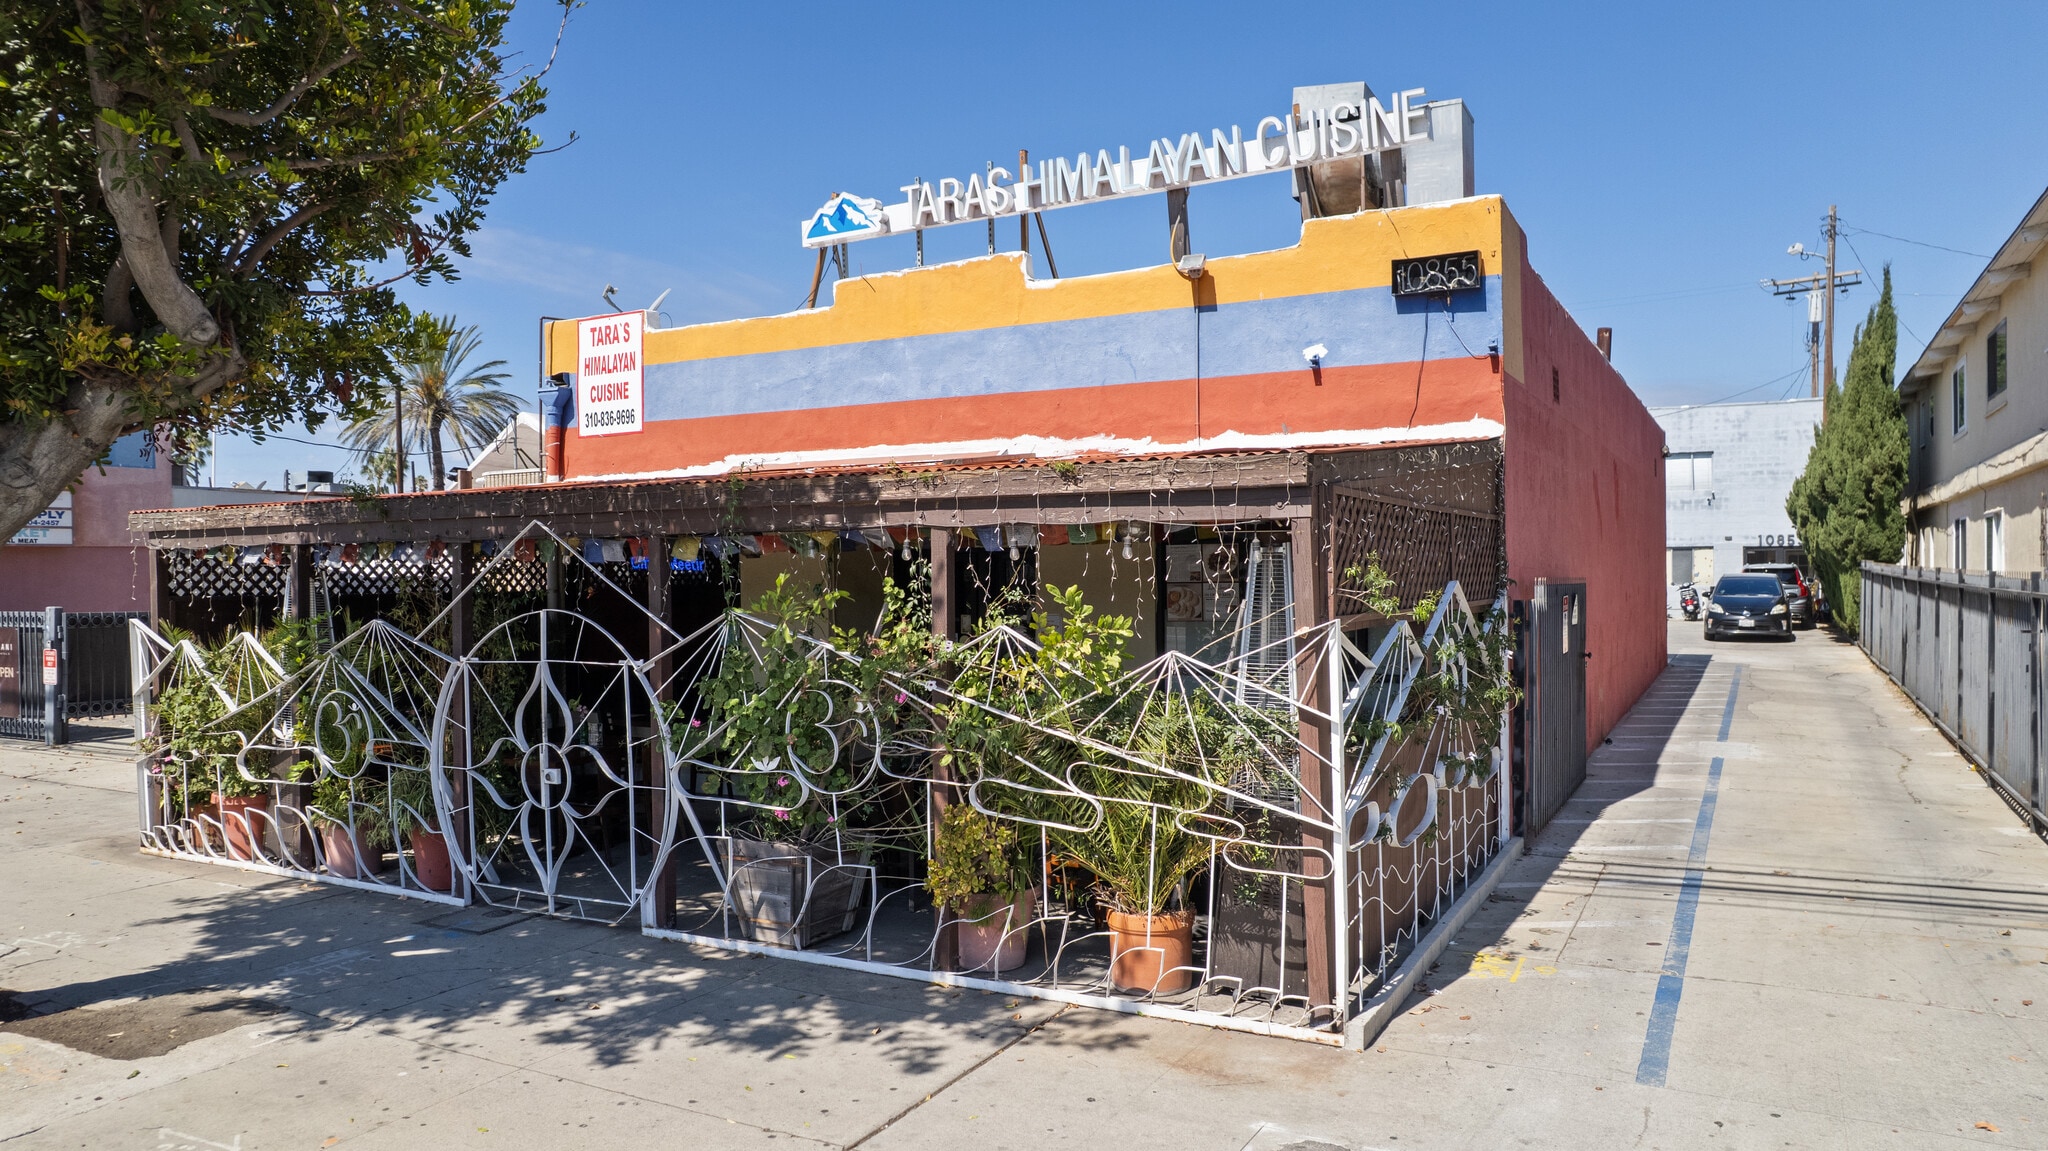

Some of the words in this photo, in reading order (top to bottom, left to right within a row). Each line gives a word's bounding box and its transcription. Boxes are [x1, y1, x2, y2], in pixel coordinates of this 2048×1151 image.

[1023, 124, 1243, 208] HIMALAYAN
[1256, 87, 1431, 169] CUISINE
[1396, 255, 1477, 293] 10855
[584, 351, 636, 376] HIMALAYAN
[590, 381, 630, 403] CUISINE
[584, 408, 636, 428] 310-836-9696
[38, 510, 66, 519] PLY
[16, 528, 49, 537] KET
[1758, 534, 1802, 547] 1085
[0, 667, 14, 678] PEN
